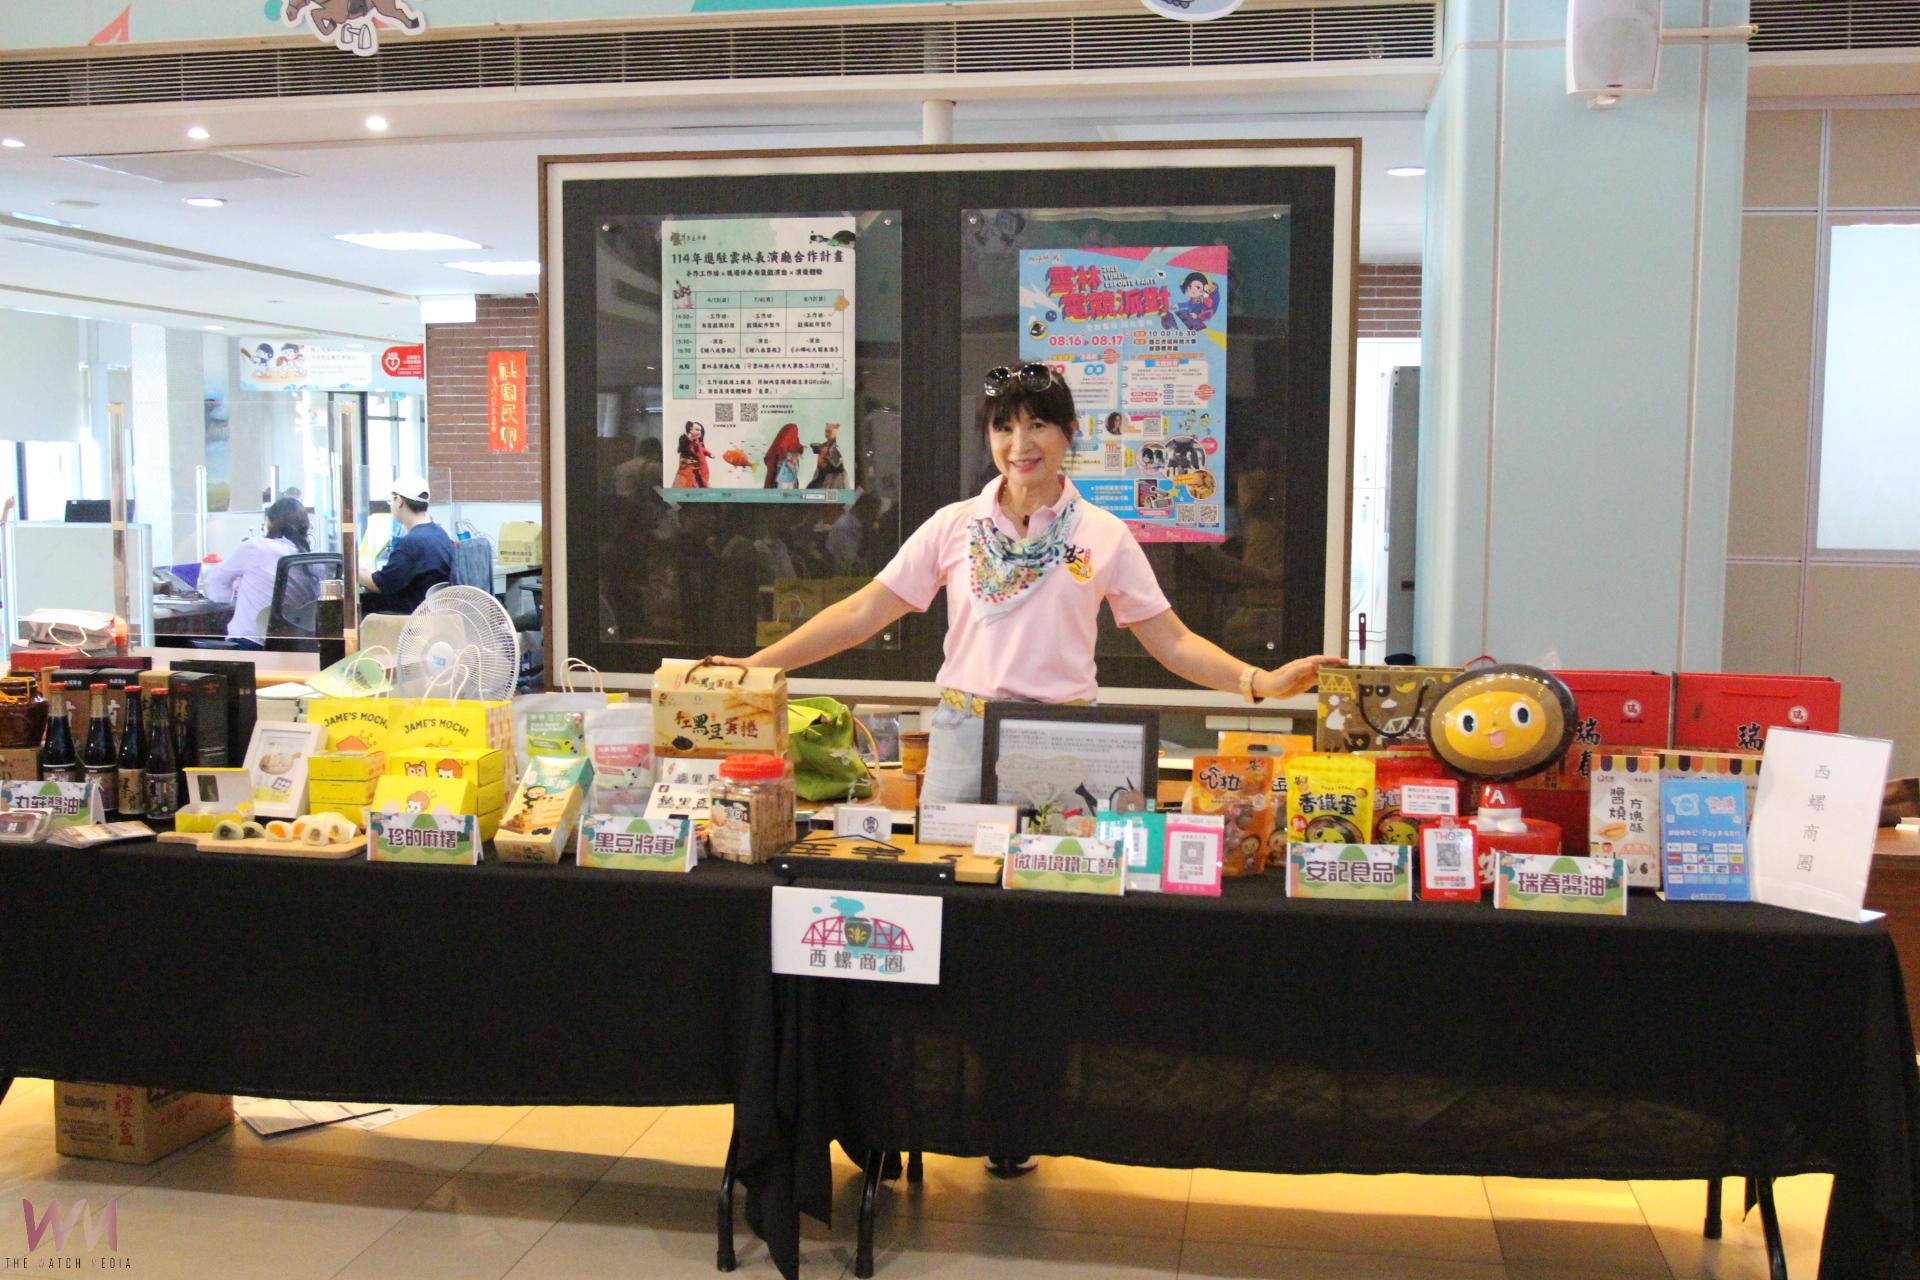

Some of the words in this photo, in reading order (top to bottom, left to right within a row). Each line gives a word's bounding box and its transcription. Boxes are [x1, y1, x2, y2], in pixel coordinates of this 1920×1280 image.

[324, 711, 357, 728] JAME'S
[404, 718, 436, 734] JAME'S
[439, 719, 470, 737] MOCHI
[1489, 789, 1506, 805] A
[594, 832, 675, 856] 黑豆將軍
[1305, 860, 1394, 883] 安記食品
[1518, 872, 1605, 897] 瑞春醬油
[809, 948, 903, 973] 西螺商圈
[114, 1085, 135, 1146] 禮盒
